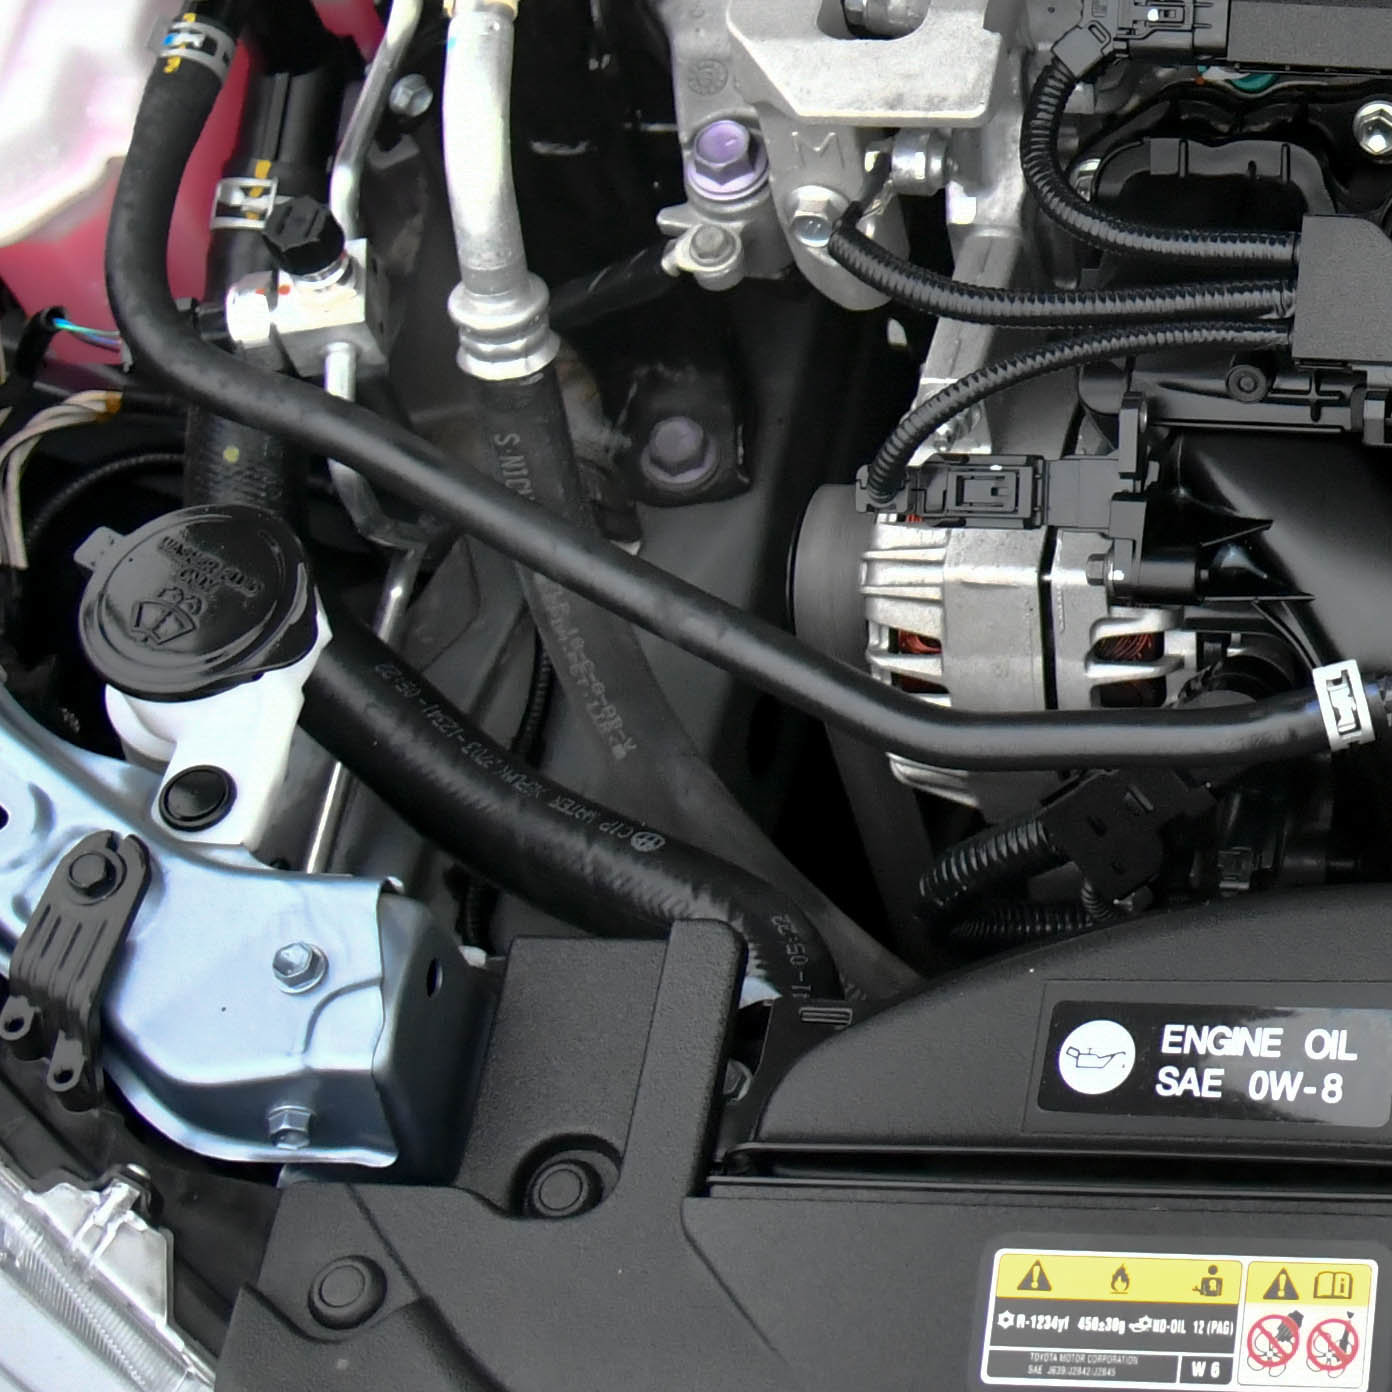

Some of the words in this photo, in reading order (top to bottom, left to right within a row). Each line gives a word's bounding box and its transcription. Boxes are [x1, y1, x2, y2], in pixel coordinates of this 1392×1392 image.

[1161, 1024, 1284, 1057] ENGINE
[1304, 1029, 1358, 1061] OIL
[1155, 1065, 1225, 1098] SAE
[1248, 1070, 1344, 1103] 0W-8
[1193, 1320, 1204, 1334] 12
[1207, 1321, 1234, 1336] (PAG)
[1030, 1352, 1058, 1362] TOYOTA
[1059, 1353, 1086, 1363] MOTOR
[1087, 1354, 1139, 1365] CORPORATION
[1027, 1365, 1042, 1375] SAE
[1191, 1361, 1206, 1377] W
[1210, 1362, 1220, 1378] 6
